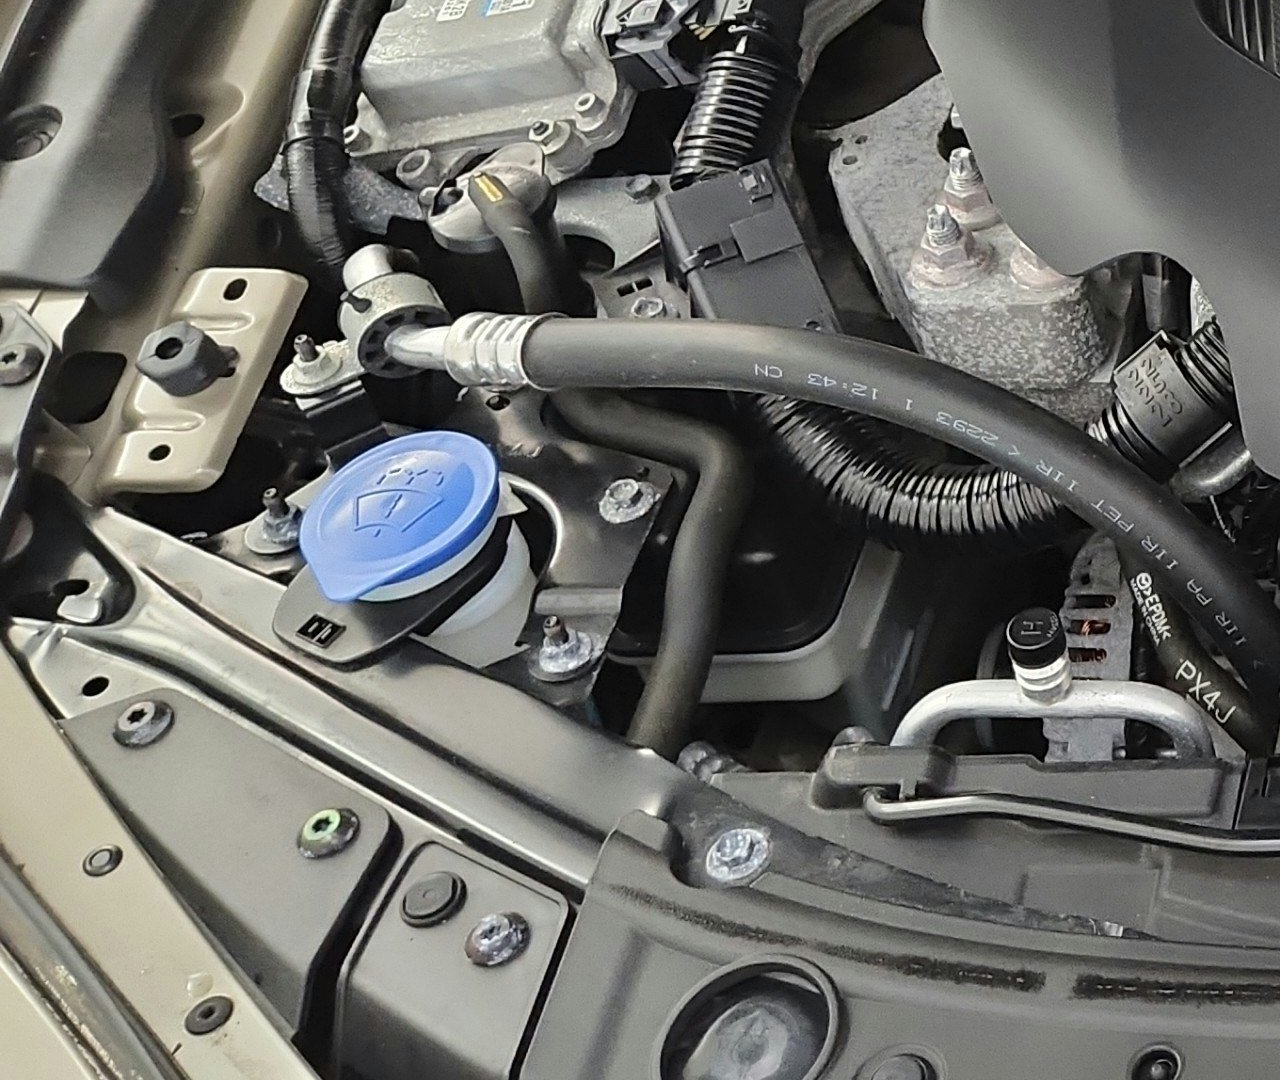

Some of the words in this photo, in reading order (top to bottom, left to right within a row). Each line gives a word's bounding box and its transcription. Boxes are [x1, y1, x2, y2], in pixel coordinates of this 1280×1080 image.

[754, 363, 783, 379] CN
[807, 372, 879, 401] 12:43
[936, 411, 999, 447] 2293
[1091, 498, 1135, 533] PET
[1186, 578, 1214, 607] PA
[1175, 659, 1237, 724] PX4J
